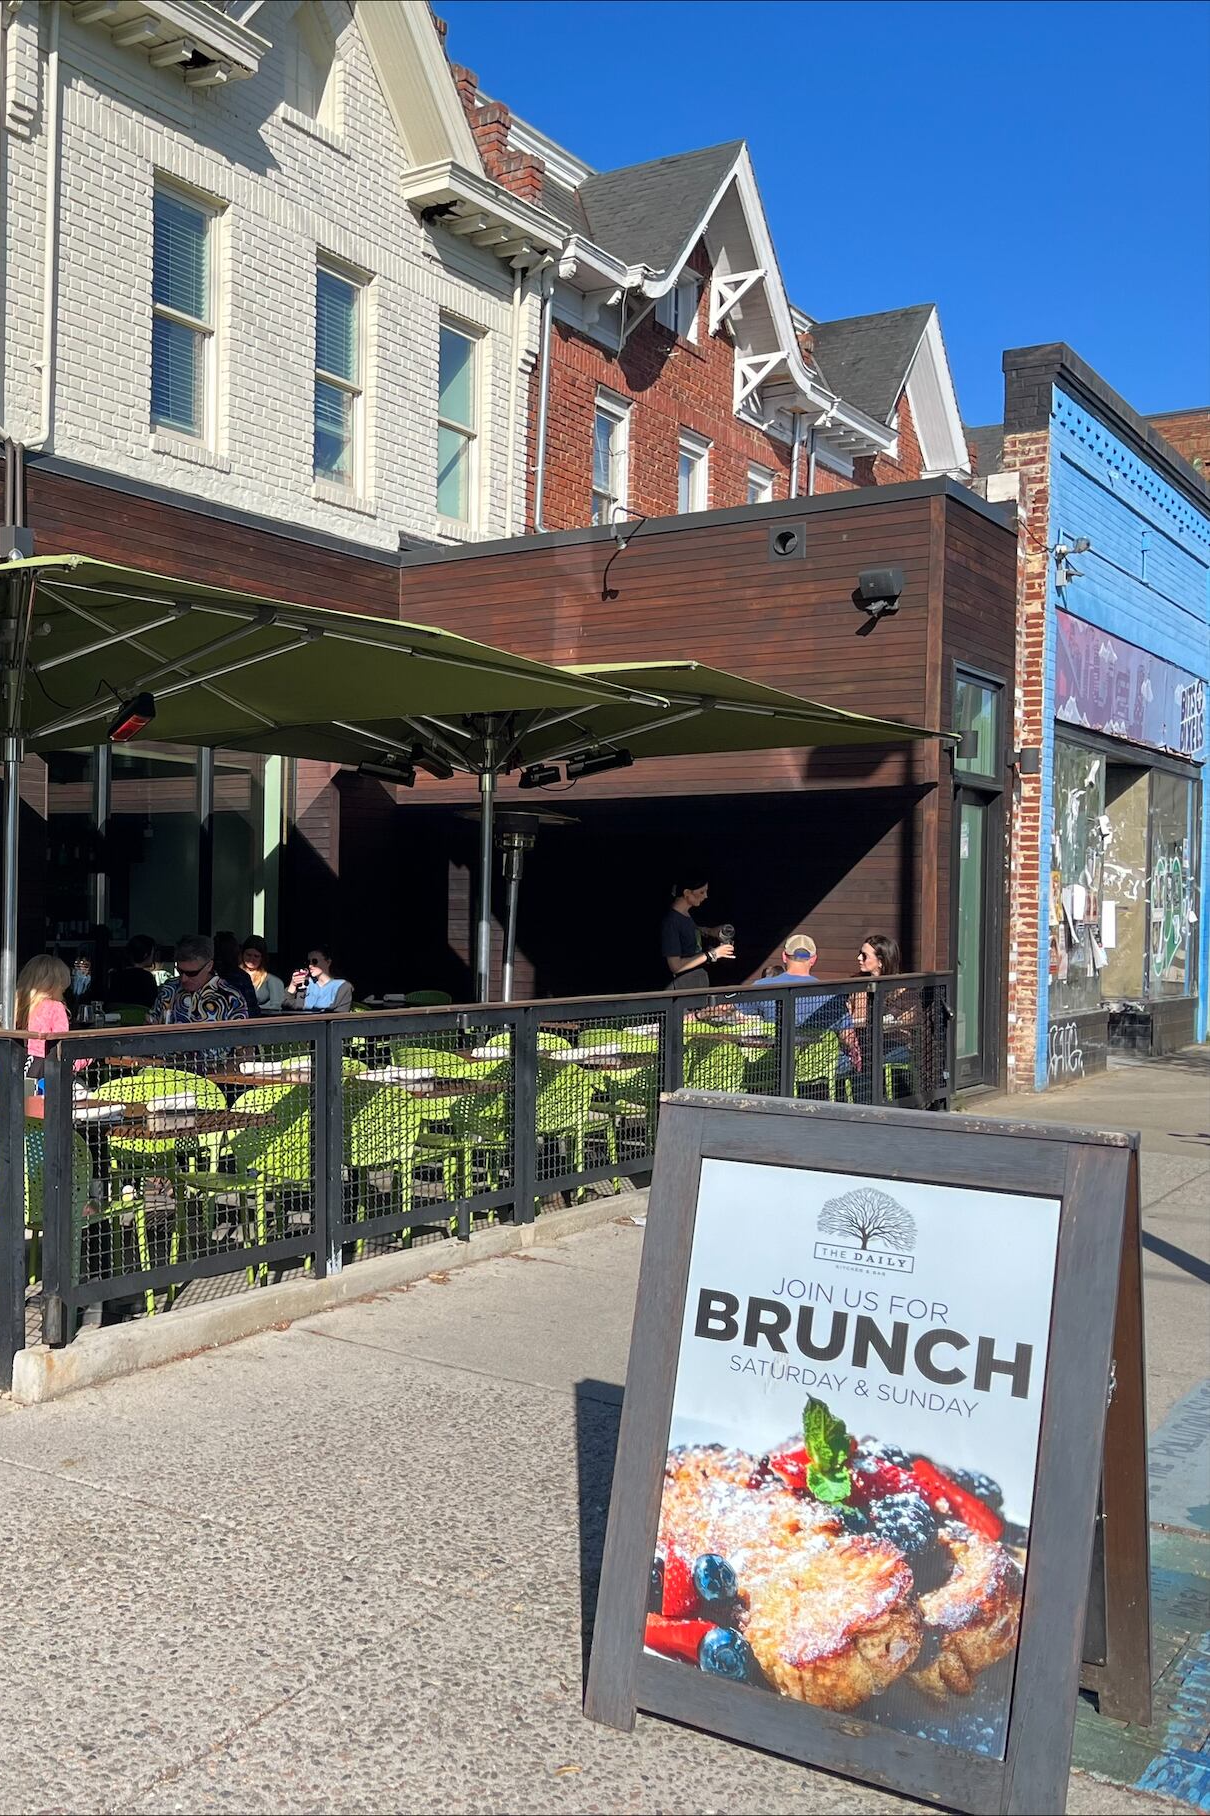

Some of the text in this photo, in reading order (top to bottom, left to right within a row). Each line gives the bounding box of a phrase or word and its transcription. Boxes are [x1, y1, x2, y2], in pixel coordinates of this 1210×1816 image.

[822, 1247, 907, 1268] THE DAILY
[772, 1277, 949, 1324] JOIN US FOR
[694, 1287, 1034, 1400] BRUNCH
[729, 1354, 980, 1419] SATURDAY & SUNDAY
